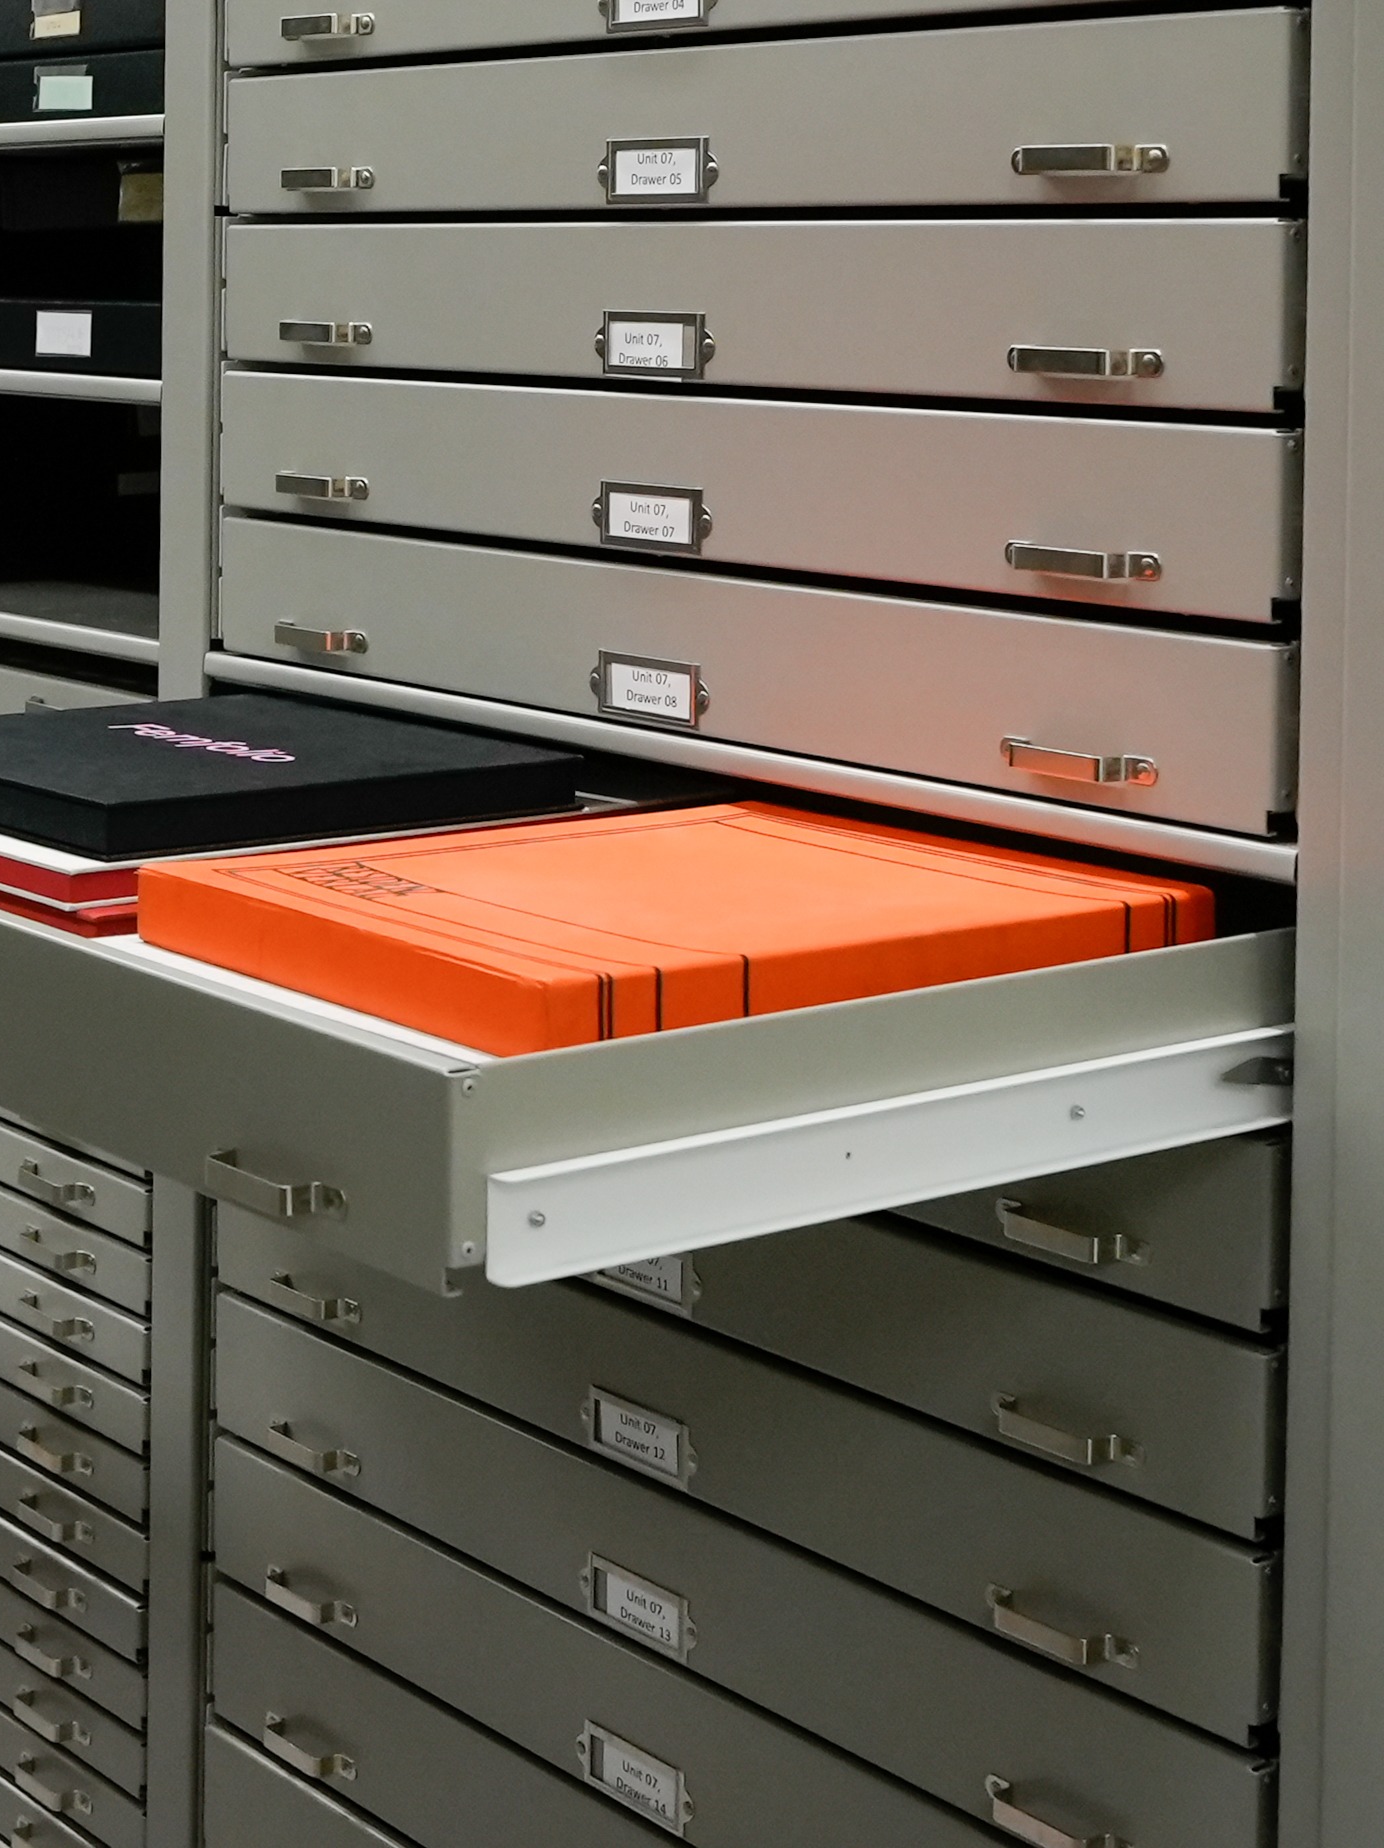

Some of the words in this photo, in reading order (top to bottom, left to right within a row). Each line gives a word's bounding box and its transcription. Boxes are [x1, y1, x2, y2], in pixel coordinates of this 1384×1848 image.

[633, 1, 669, 13] Drawer
[672, 0, 685, 10] 04
[637, 152, 658, 165] Unit
[660, 152, 676, 166] 07,
[631, 173, 667, 185] Drawer
[669, 172, 682, 185] 05
[624, 332, 644, 344] Unit
[646, 333, 663, 348] 07,
[618, 352, 653, 366] Drawer
[655, 354, 668, 368] 06
[630, 500, 650, 515] Unit
[653, 503, 669, 519] 07,
[623, 520, 659, 536] Drawer
[662, 525, 675, 538] 07
[632, 670, 653, 684] Unit
[655, 672, 671, 688] 07,
[626, 689, 662, 705] Drawer
[664, 694, 678, 708] 08
[107, 722, 296, 763] Femfolio
[657, 1276, 668, 1291] 11
[619, 1412, 641, 1430] Unit
[642, 1420, 660, 1439] 07,
[615, 1430, 650, 1455] Drawer
[653, 1446, 666, 1461] 12
[626, 1589, 647, 1610] Unit
[649, 1601, 666, 1620] 07,
[620, 1605, 655, 1632] Drawer
[659, 1626, 671, 1642] 13
[621, 1759, 642, 1782] Unit
[645, 1773, 661, 1794] 07,
[616, 1776, 652, 1806] Drawer
[654, 1799, 666, 1815] 14
